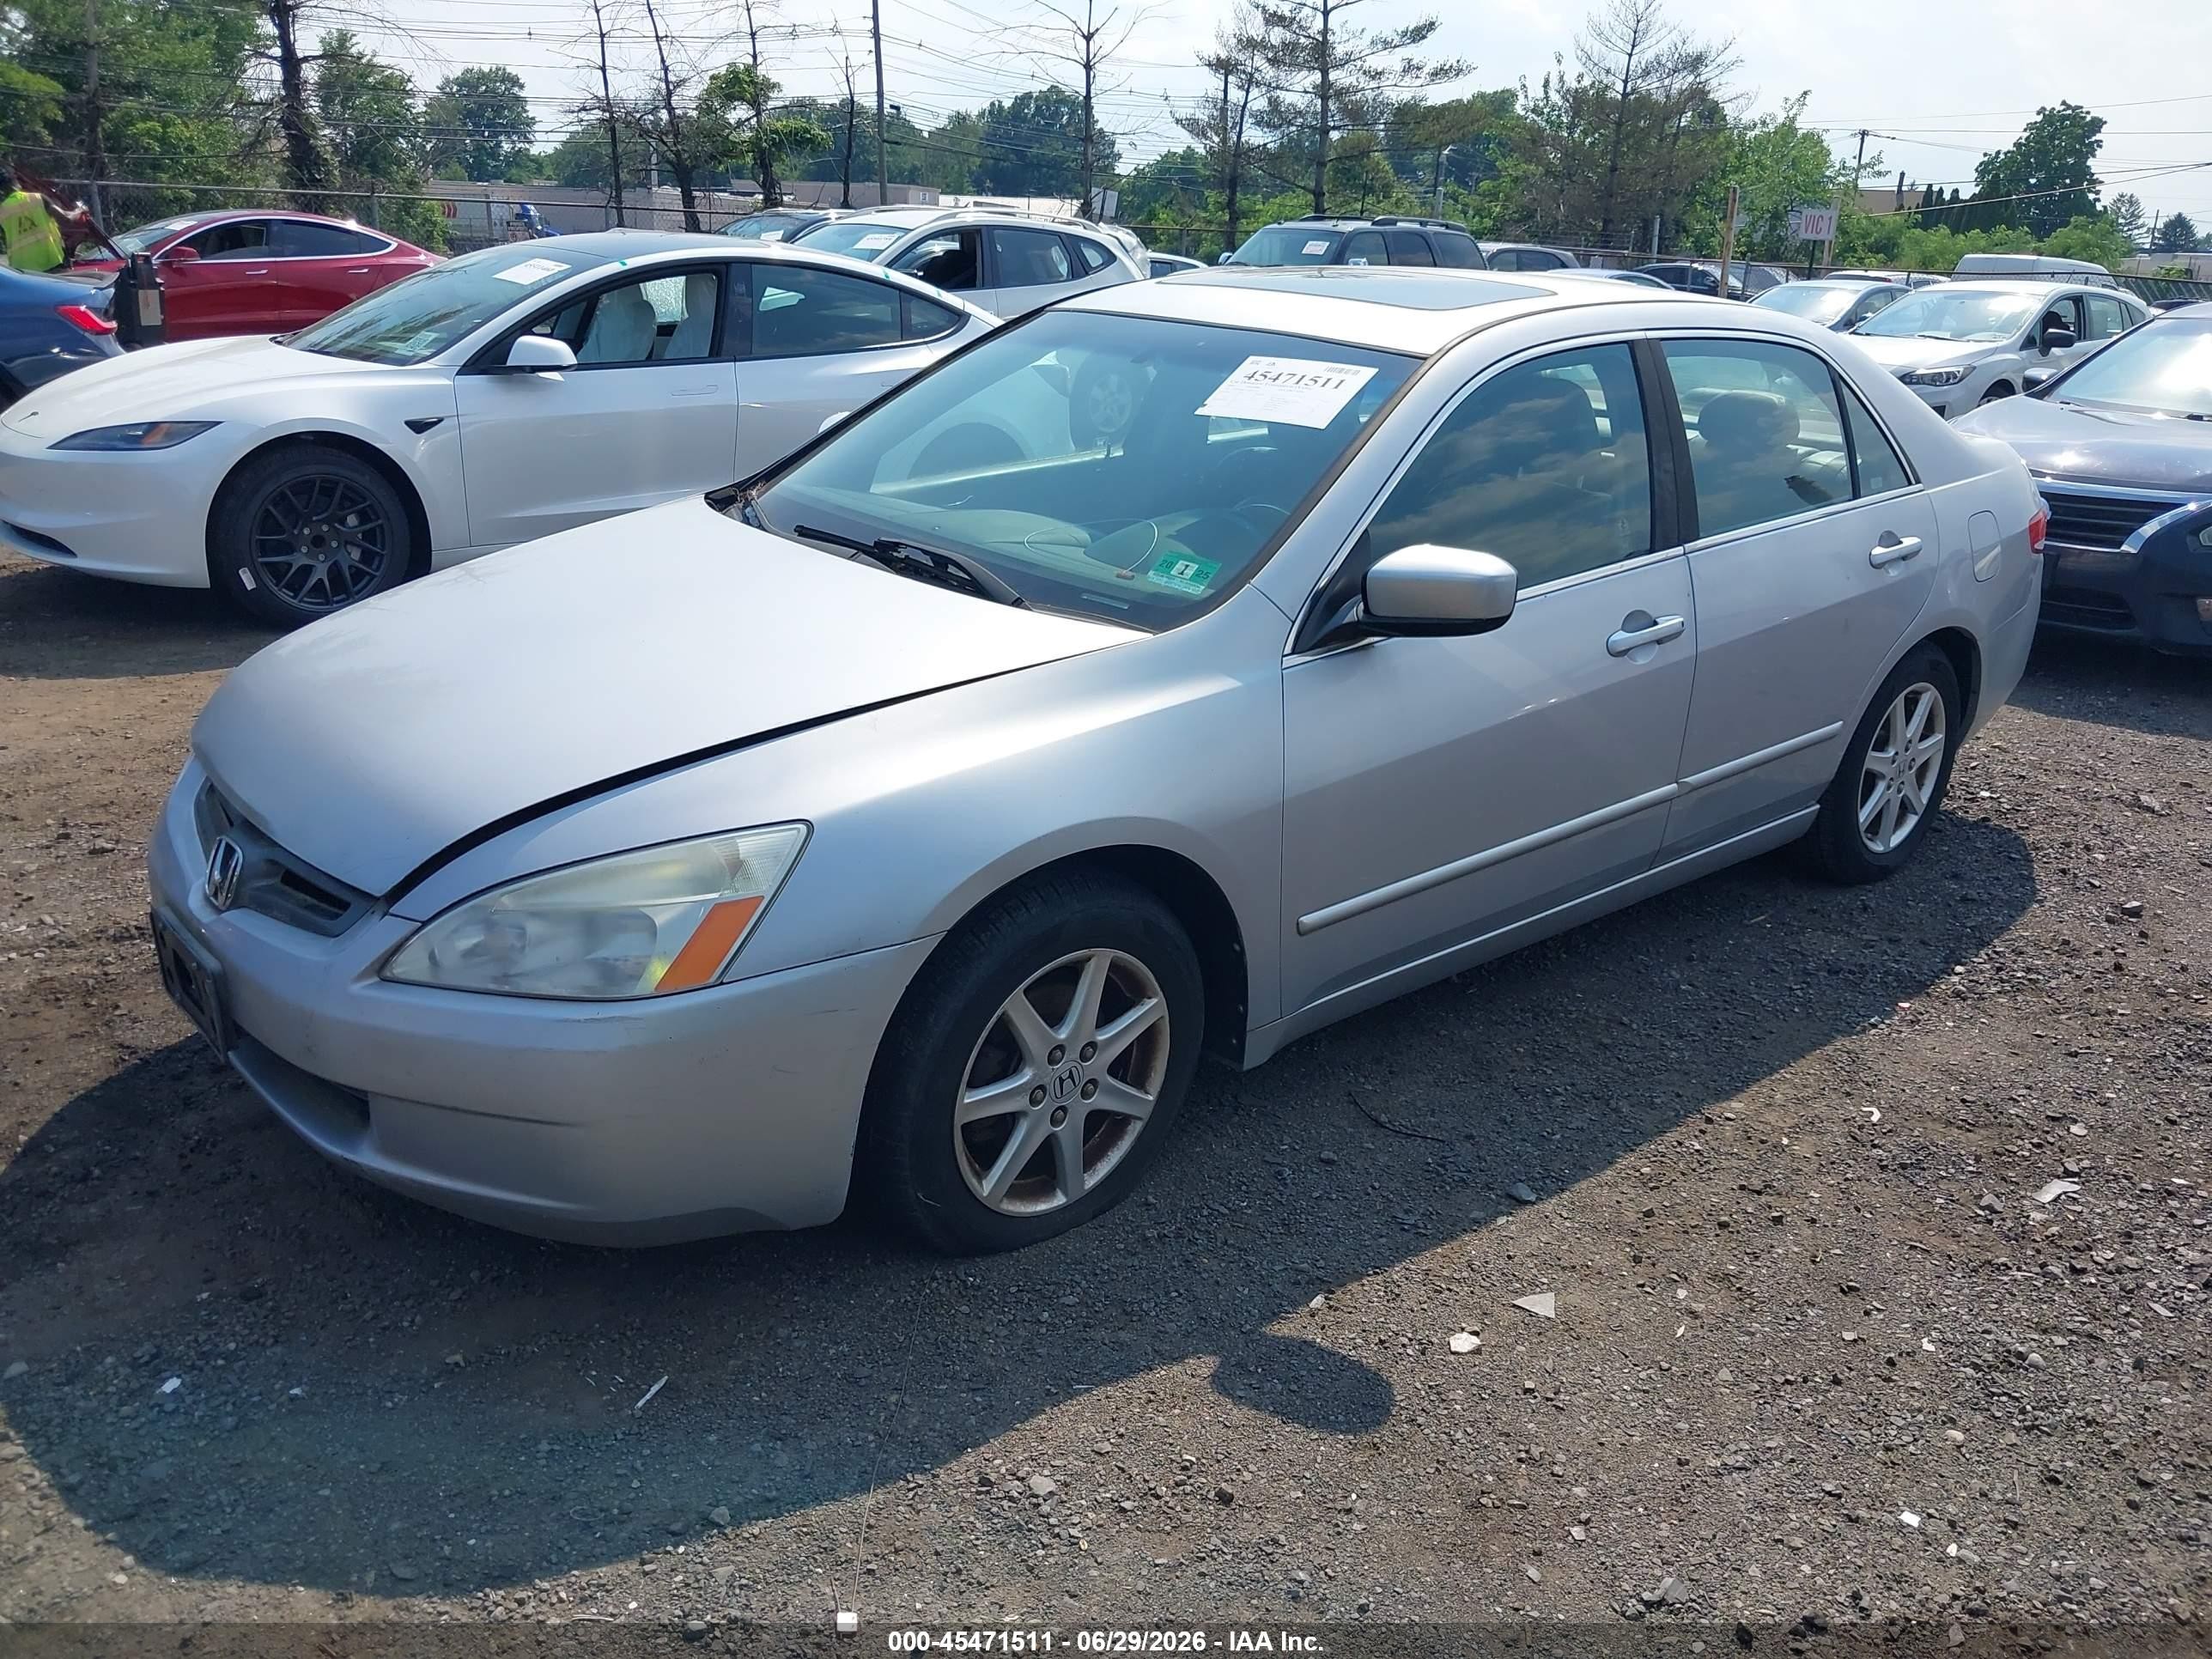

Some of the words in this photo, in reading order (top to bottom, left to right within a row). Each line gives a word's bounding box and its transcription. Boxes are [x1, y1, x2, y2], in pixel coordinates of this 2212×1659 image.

[1805, 215, 1824, 234] VIC
[1827, 216, 1832, 234] 1
[1243, 370, 1345, 389] 45471511
[1159, 559, 1173, 568] 20
[1195, 570, 1211, 580] 25
